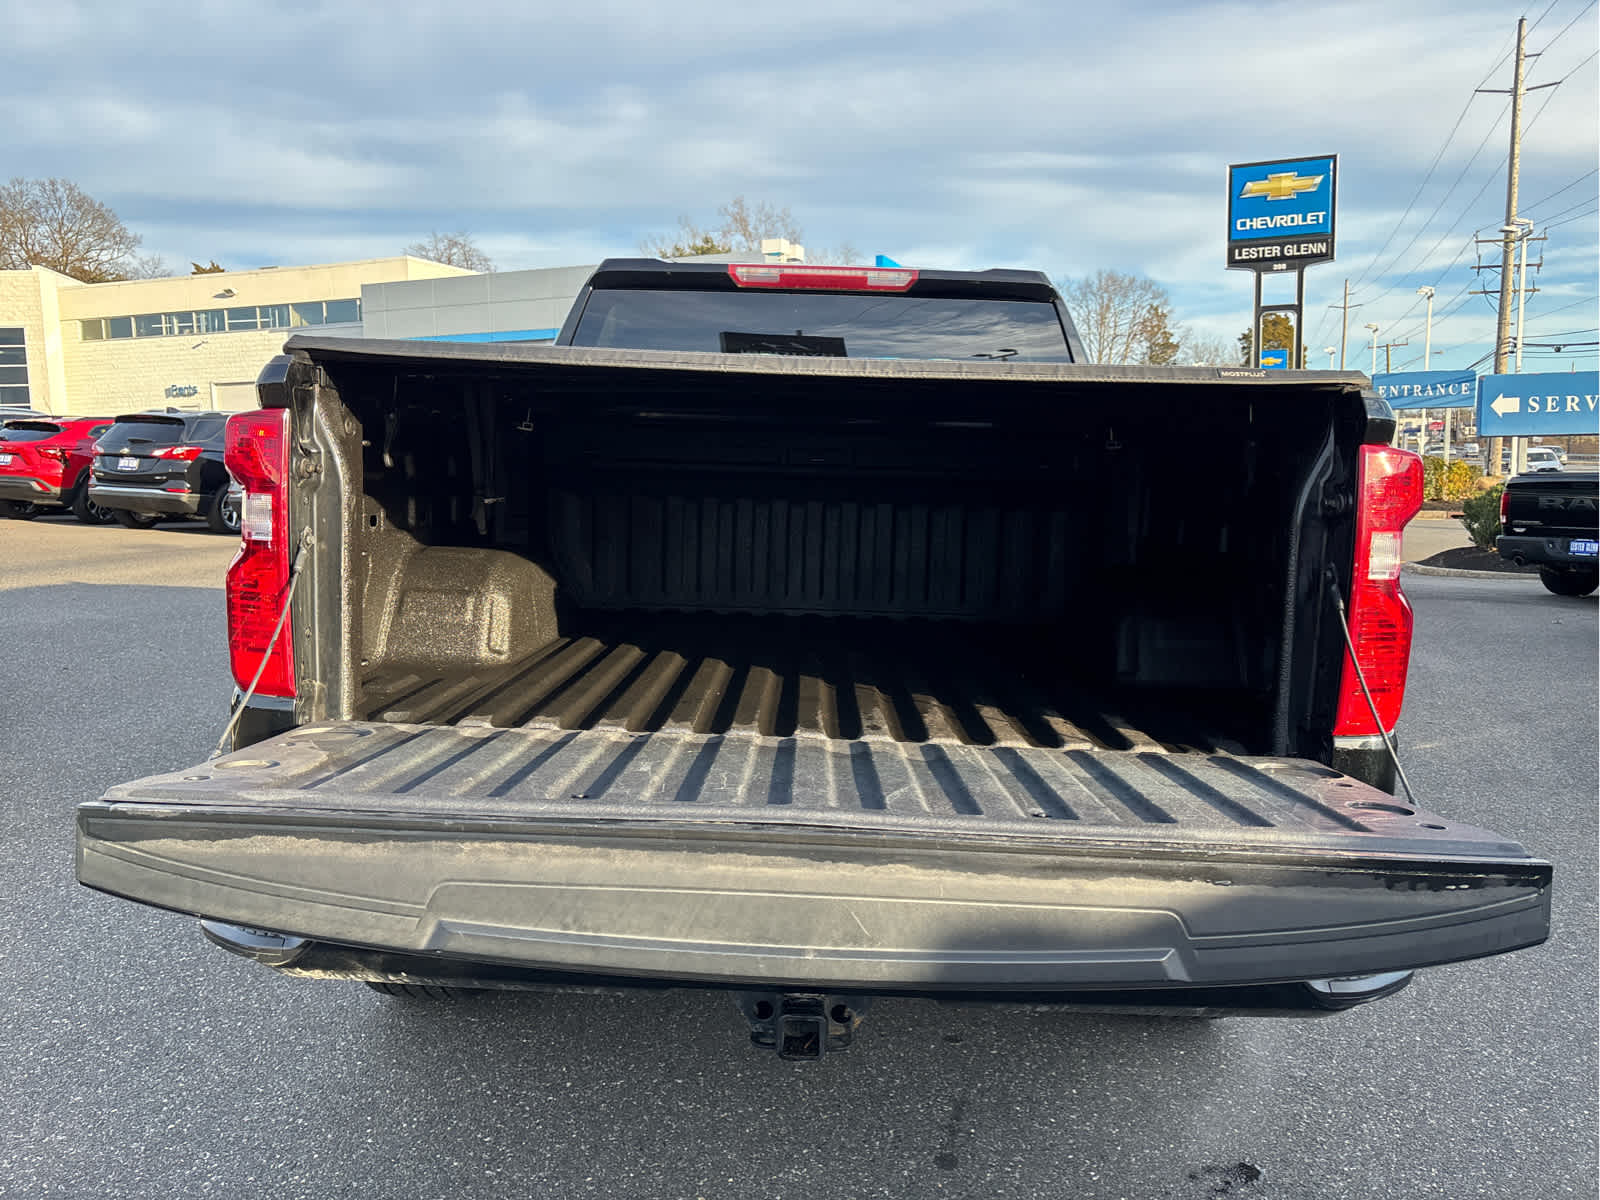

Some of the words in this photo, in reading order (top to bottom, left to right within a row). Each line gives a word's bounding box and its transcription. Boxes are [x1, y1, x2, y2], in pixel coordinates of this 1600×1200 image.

[1236, 211, 1327, 231] CHEVROLET
[1234, 245, 1281, 260] LESTER
[1284, 242, 1327, 257] GLENN
[1378, 382, 1471, 399] ENTRANCE
[1527, 394, 1599, 413] SERV
